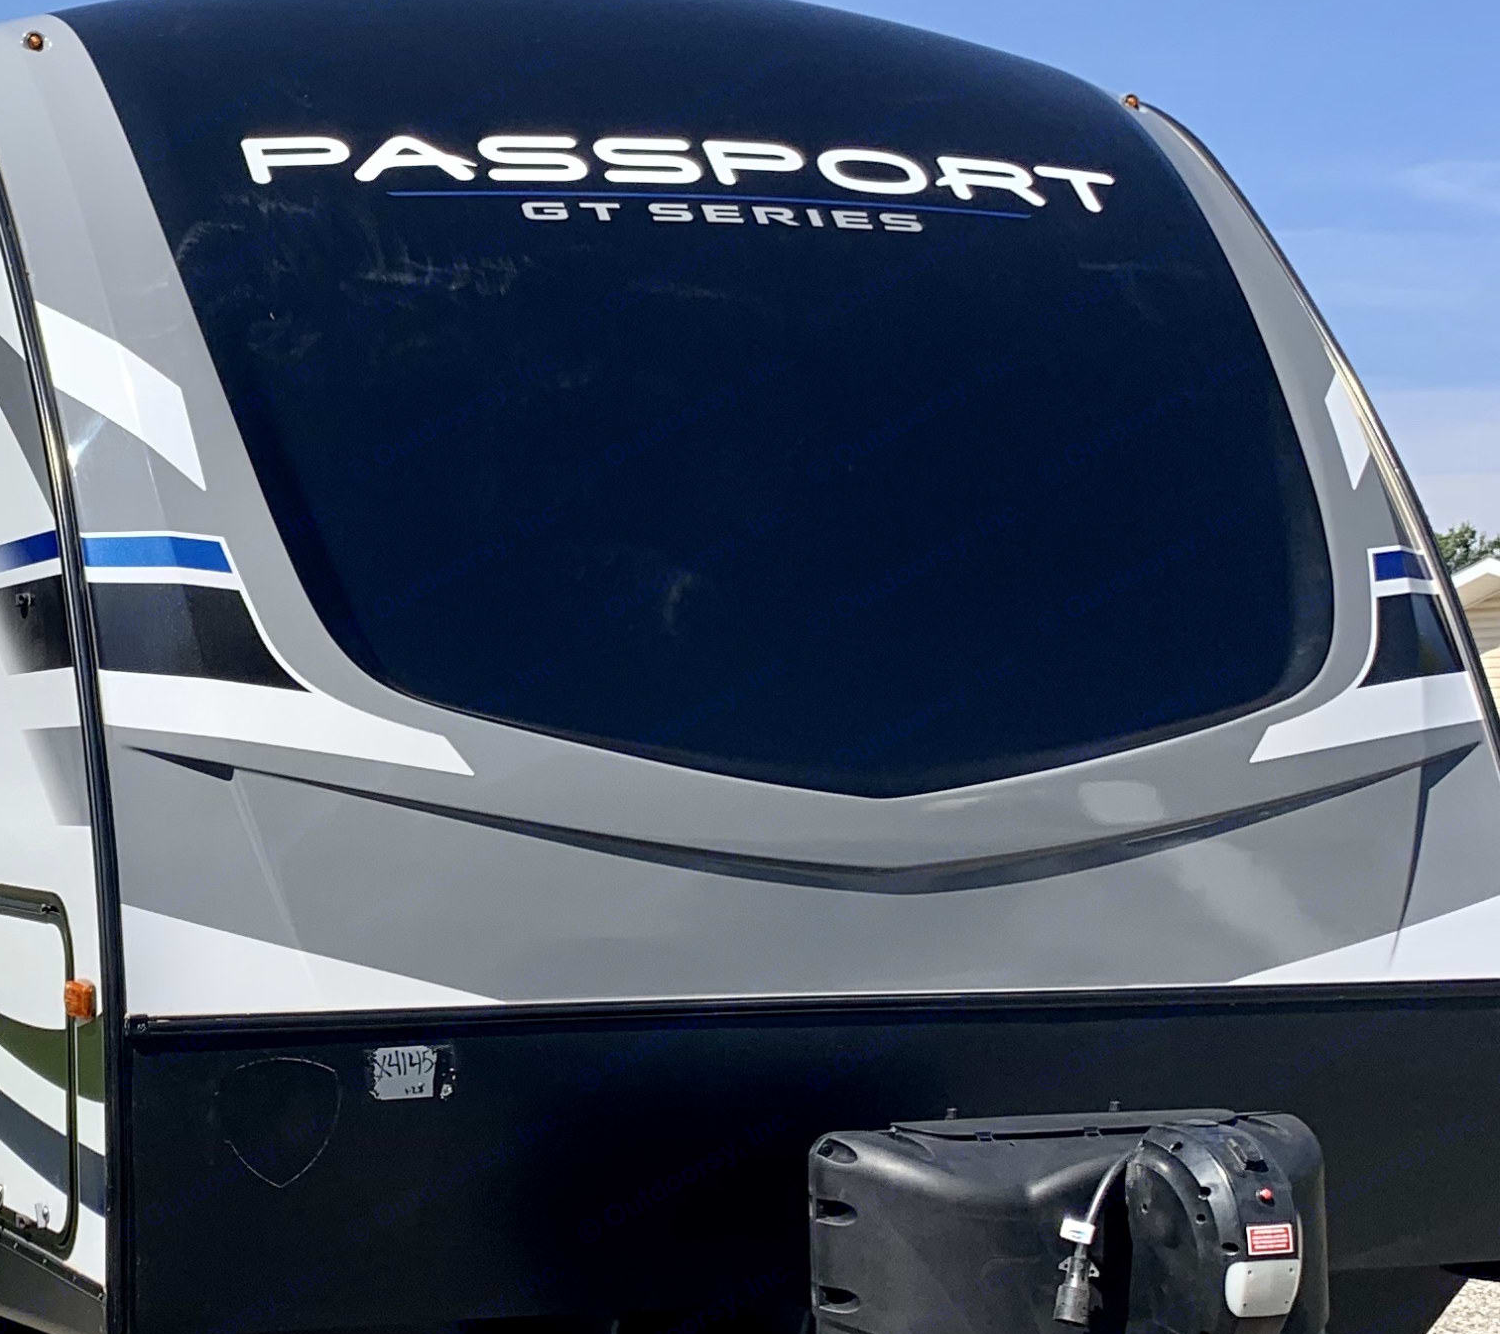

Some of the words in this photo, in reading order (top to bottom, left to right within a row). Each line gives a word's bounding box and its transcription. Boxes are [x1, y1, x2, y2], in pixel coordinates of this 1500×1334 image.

[240, 135, 1115, 213] PASSPORT
[521, 201, 621, 222] GT
[647, 202, 924, 233] SERIES
